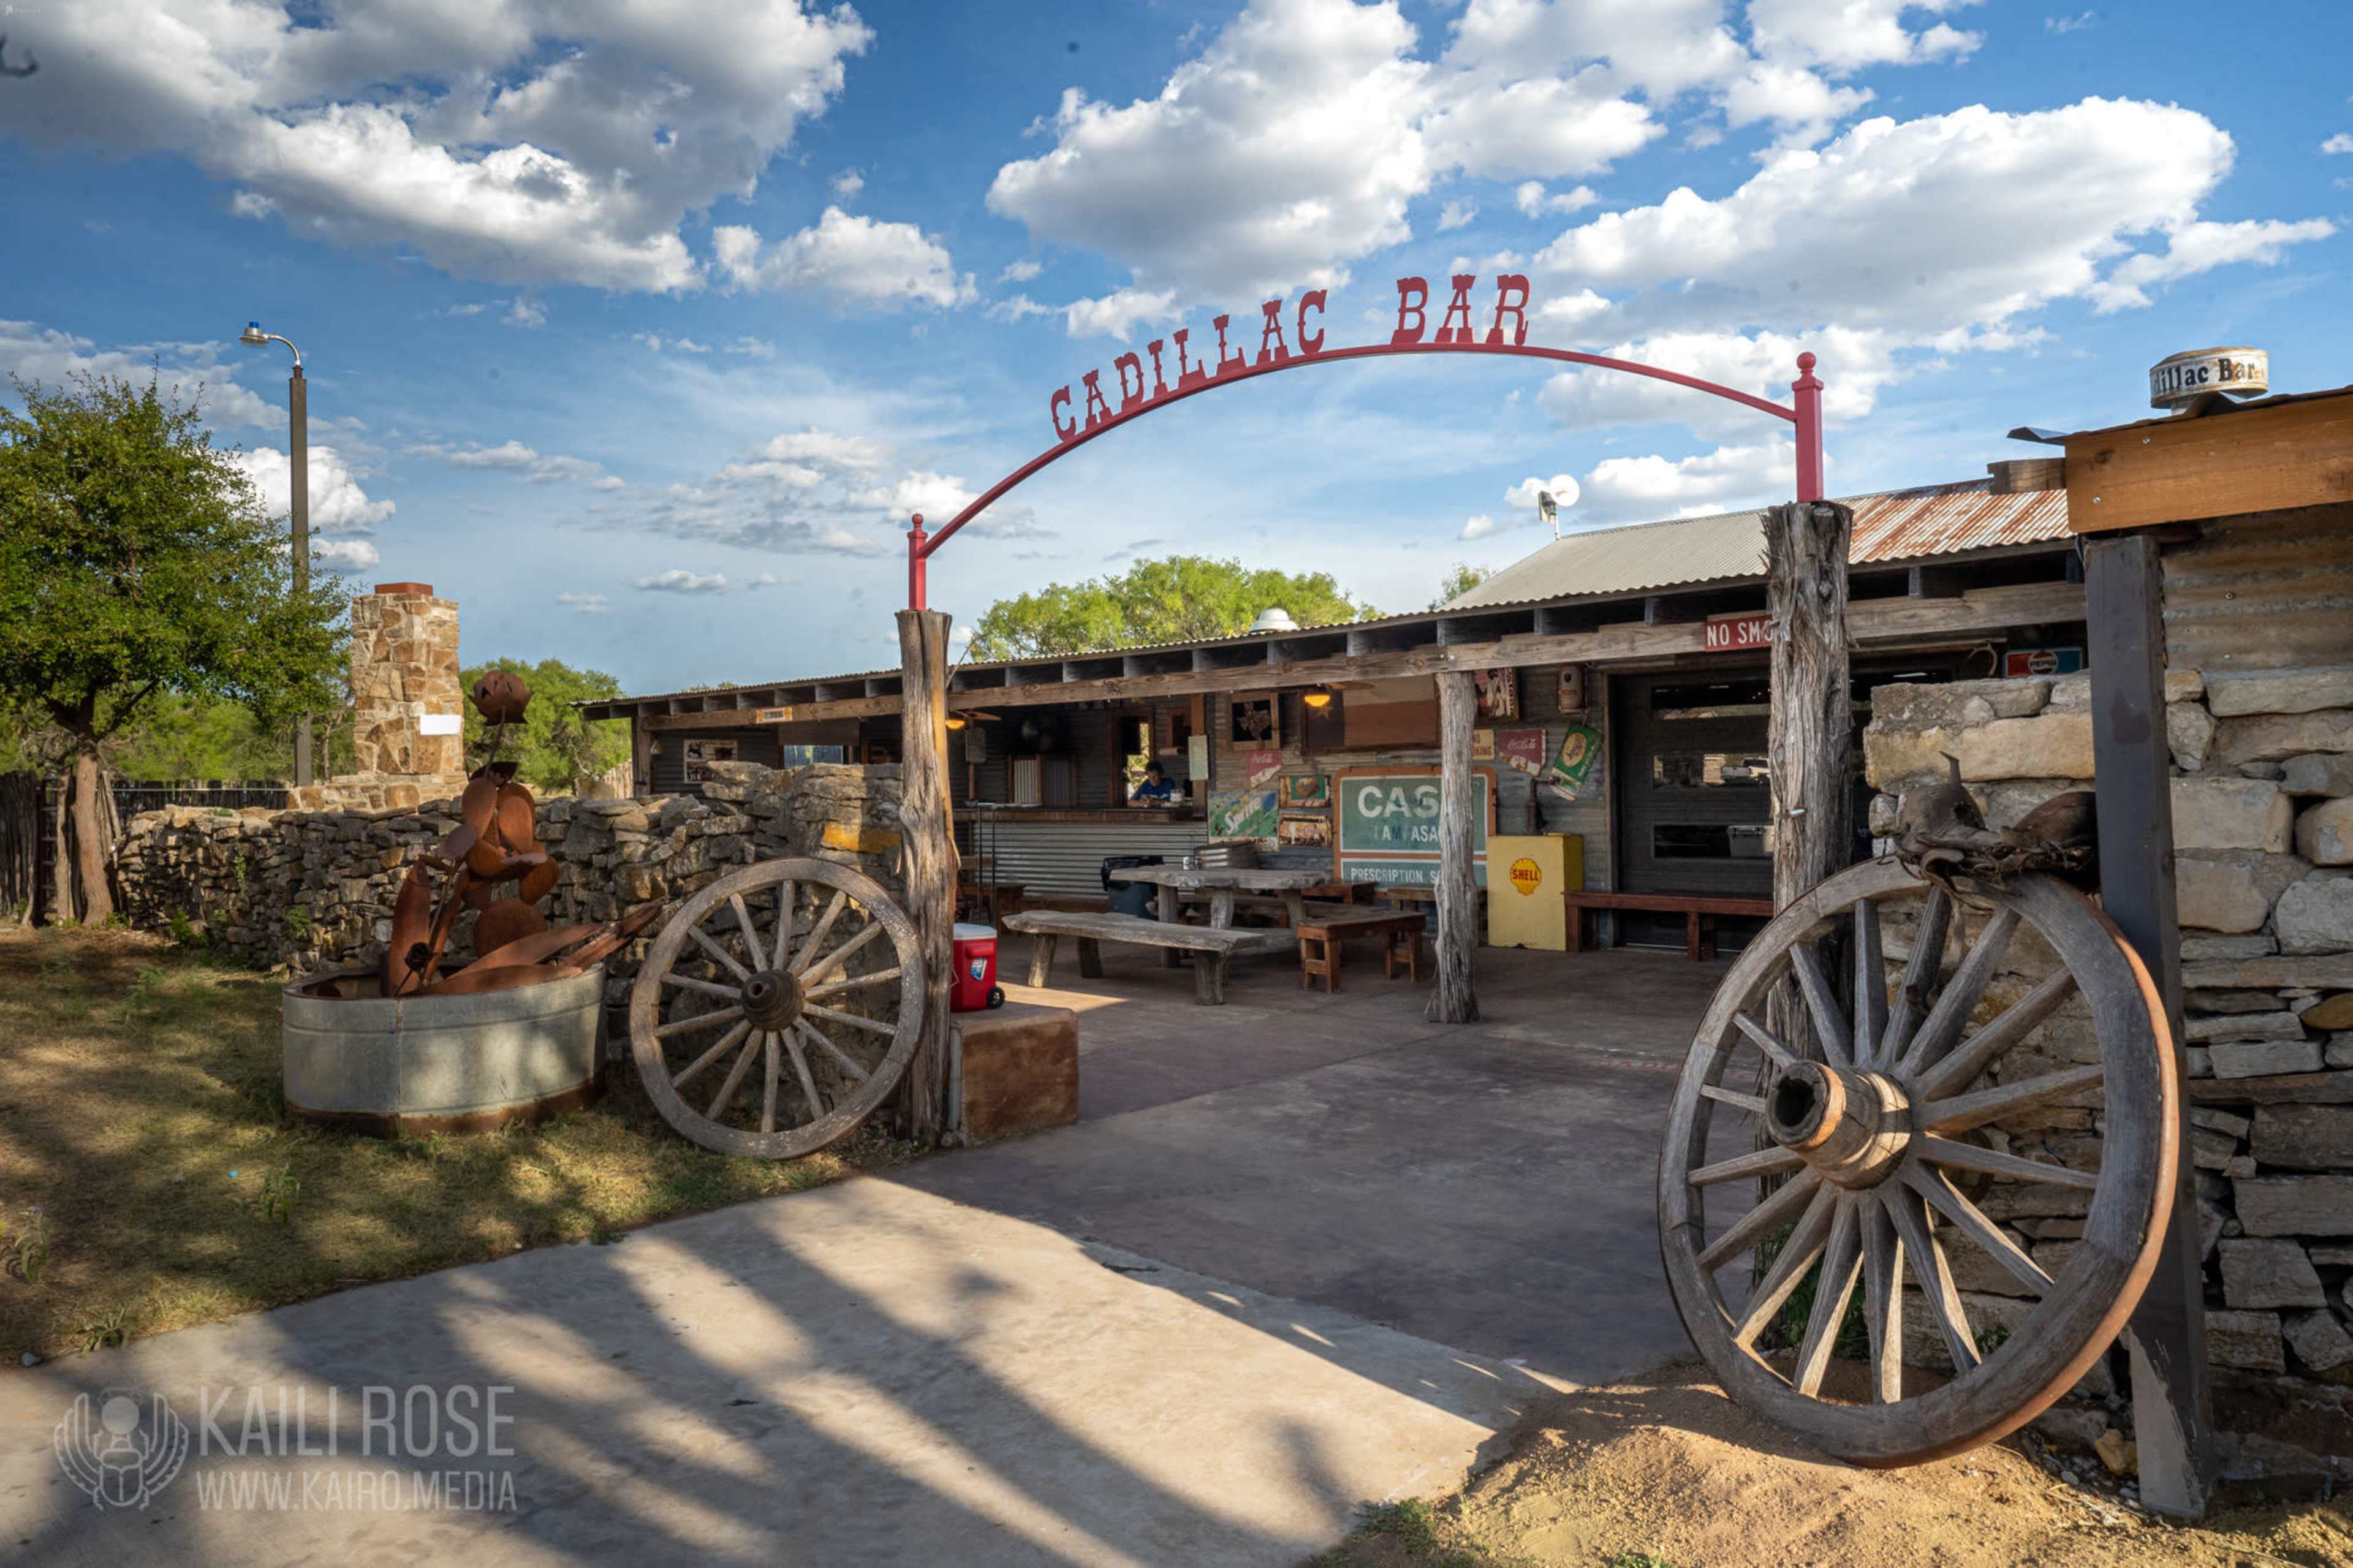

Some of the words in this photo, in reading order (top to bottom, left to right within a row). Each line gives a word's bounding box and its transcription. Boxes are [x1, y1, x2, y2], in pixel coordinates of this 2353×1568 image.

[1050, 289, 1327, 442] CADILLAC
[1390, 274, 1529, 345] BAR
[2218, 358, 2256, 382] Bar
[1707, 624, 1730, 646] NO
[1351, 868, 1423, 883] PRESCRIPTION
[1512, 869, 1539, 881] SHELL
